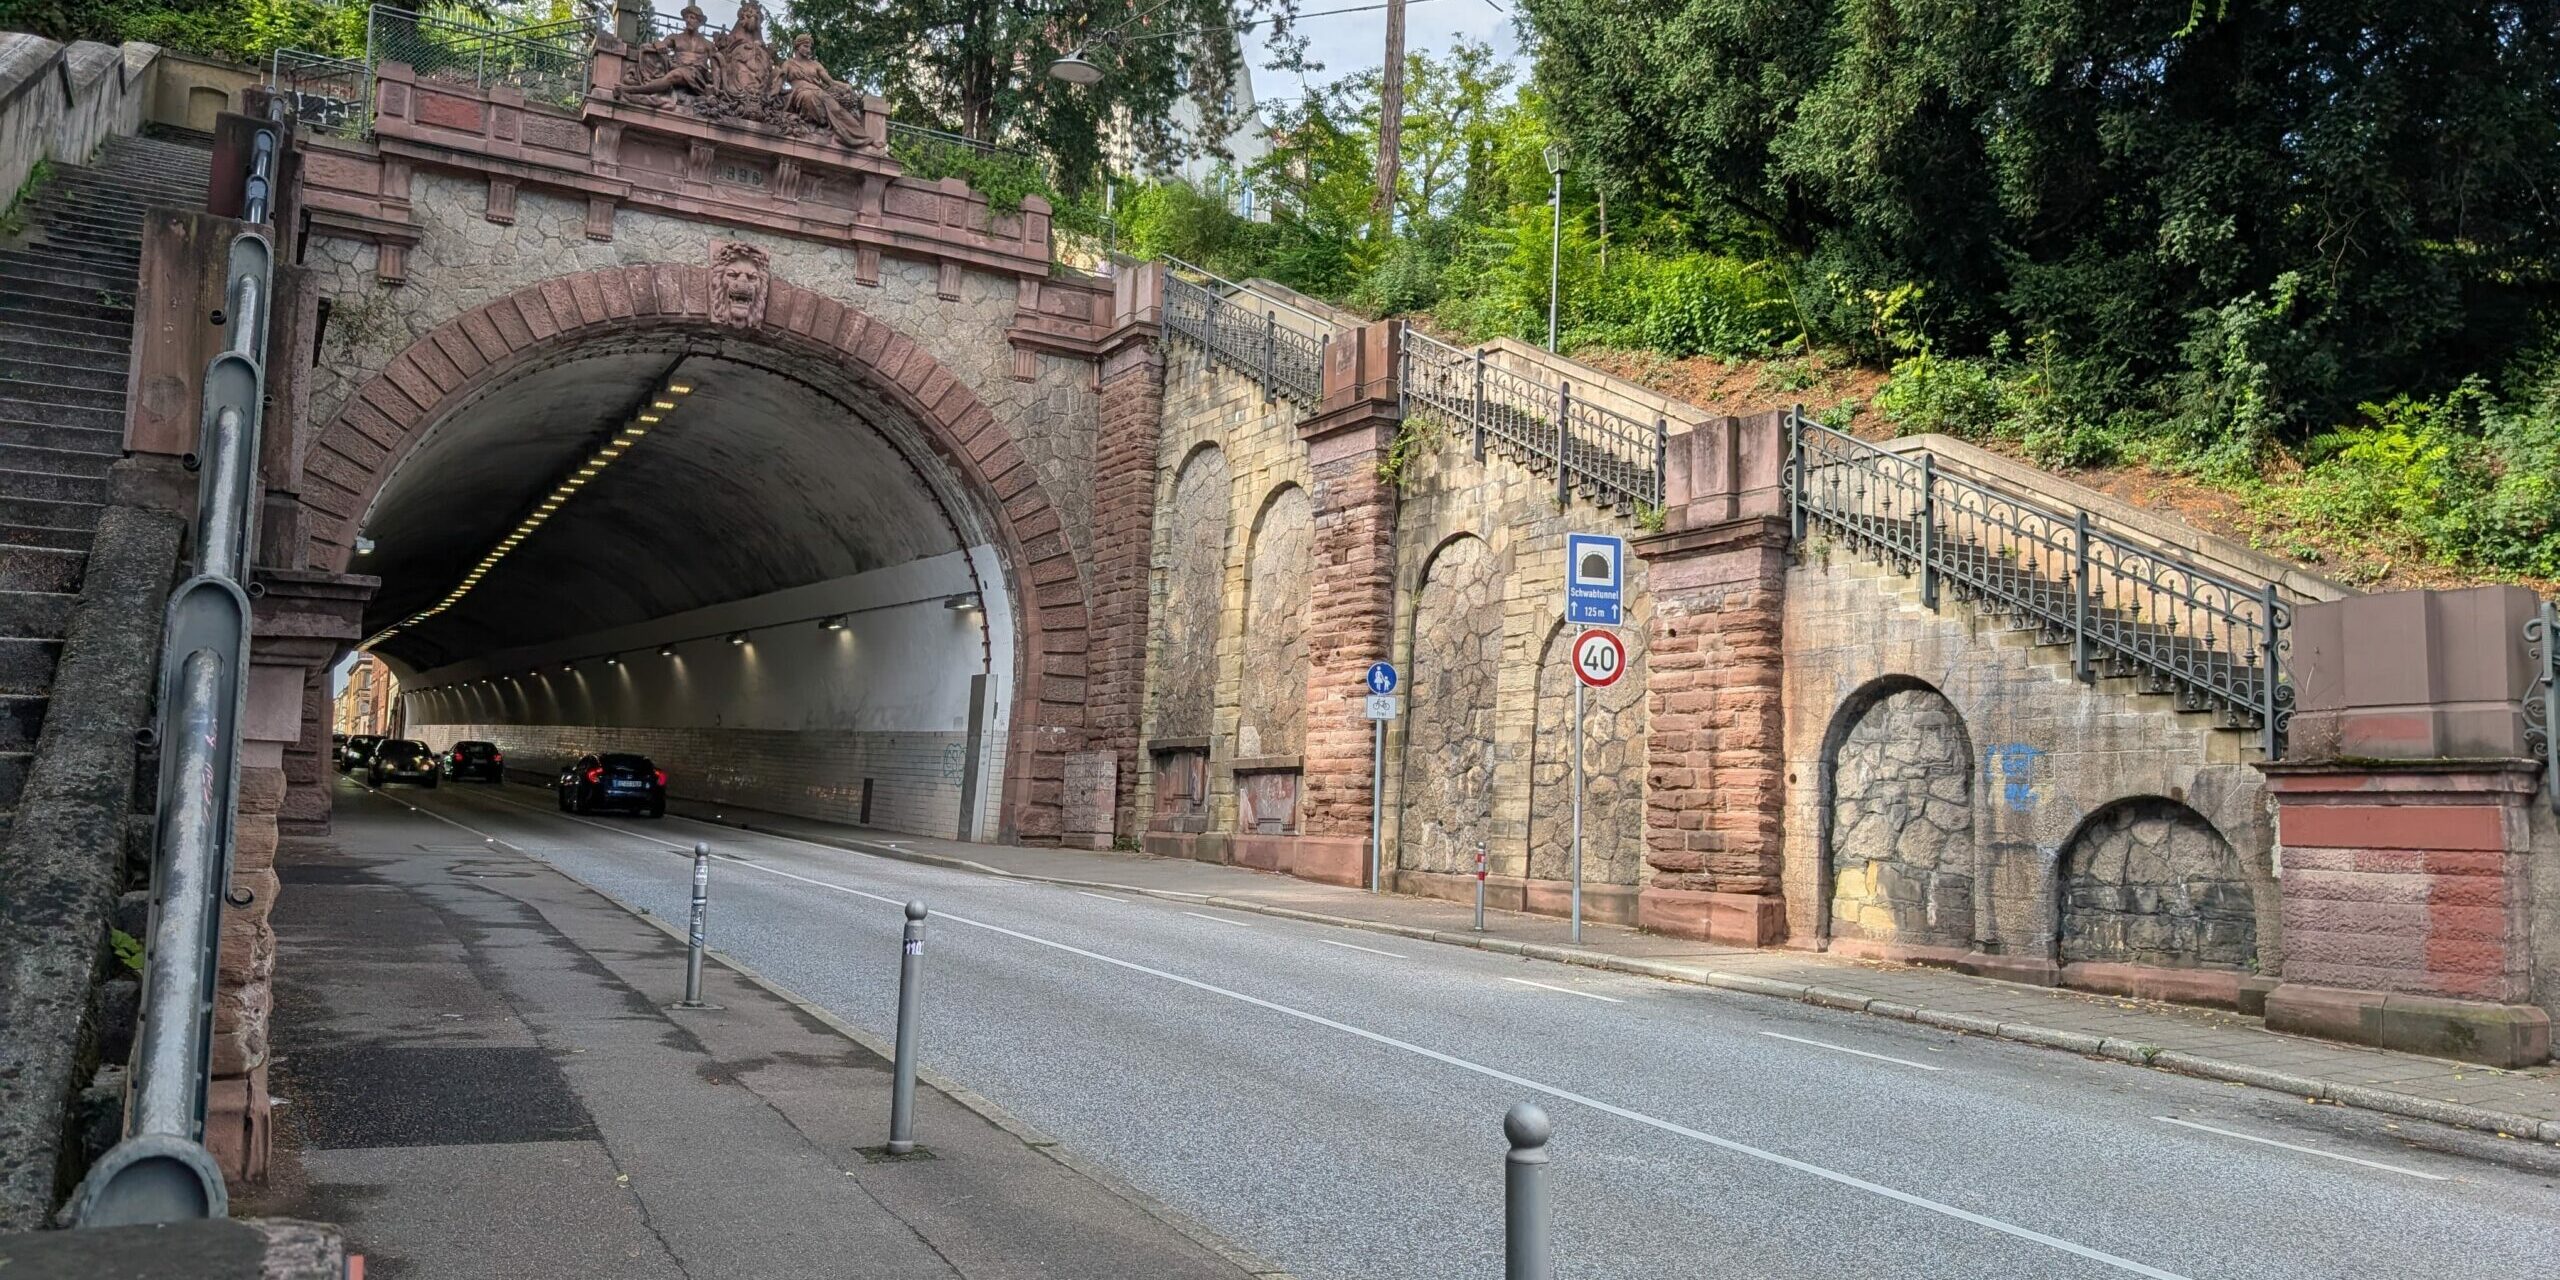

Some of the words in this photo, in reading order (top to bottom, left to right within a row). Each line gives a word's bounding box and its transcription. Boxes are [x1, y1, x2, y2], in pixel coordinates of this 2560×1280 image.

[1570, 587, 1619, 600] Schwabtunnel
[1584, 606, 1597, 617] 125
[1597, 609, 1605, 618] m
[1583, 645, 1614, 671] 40
